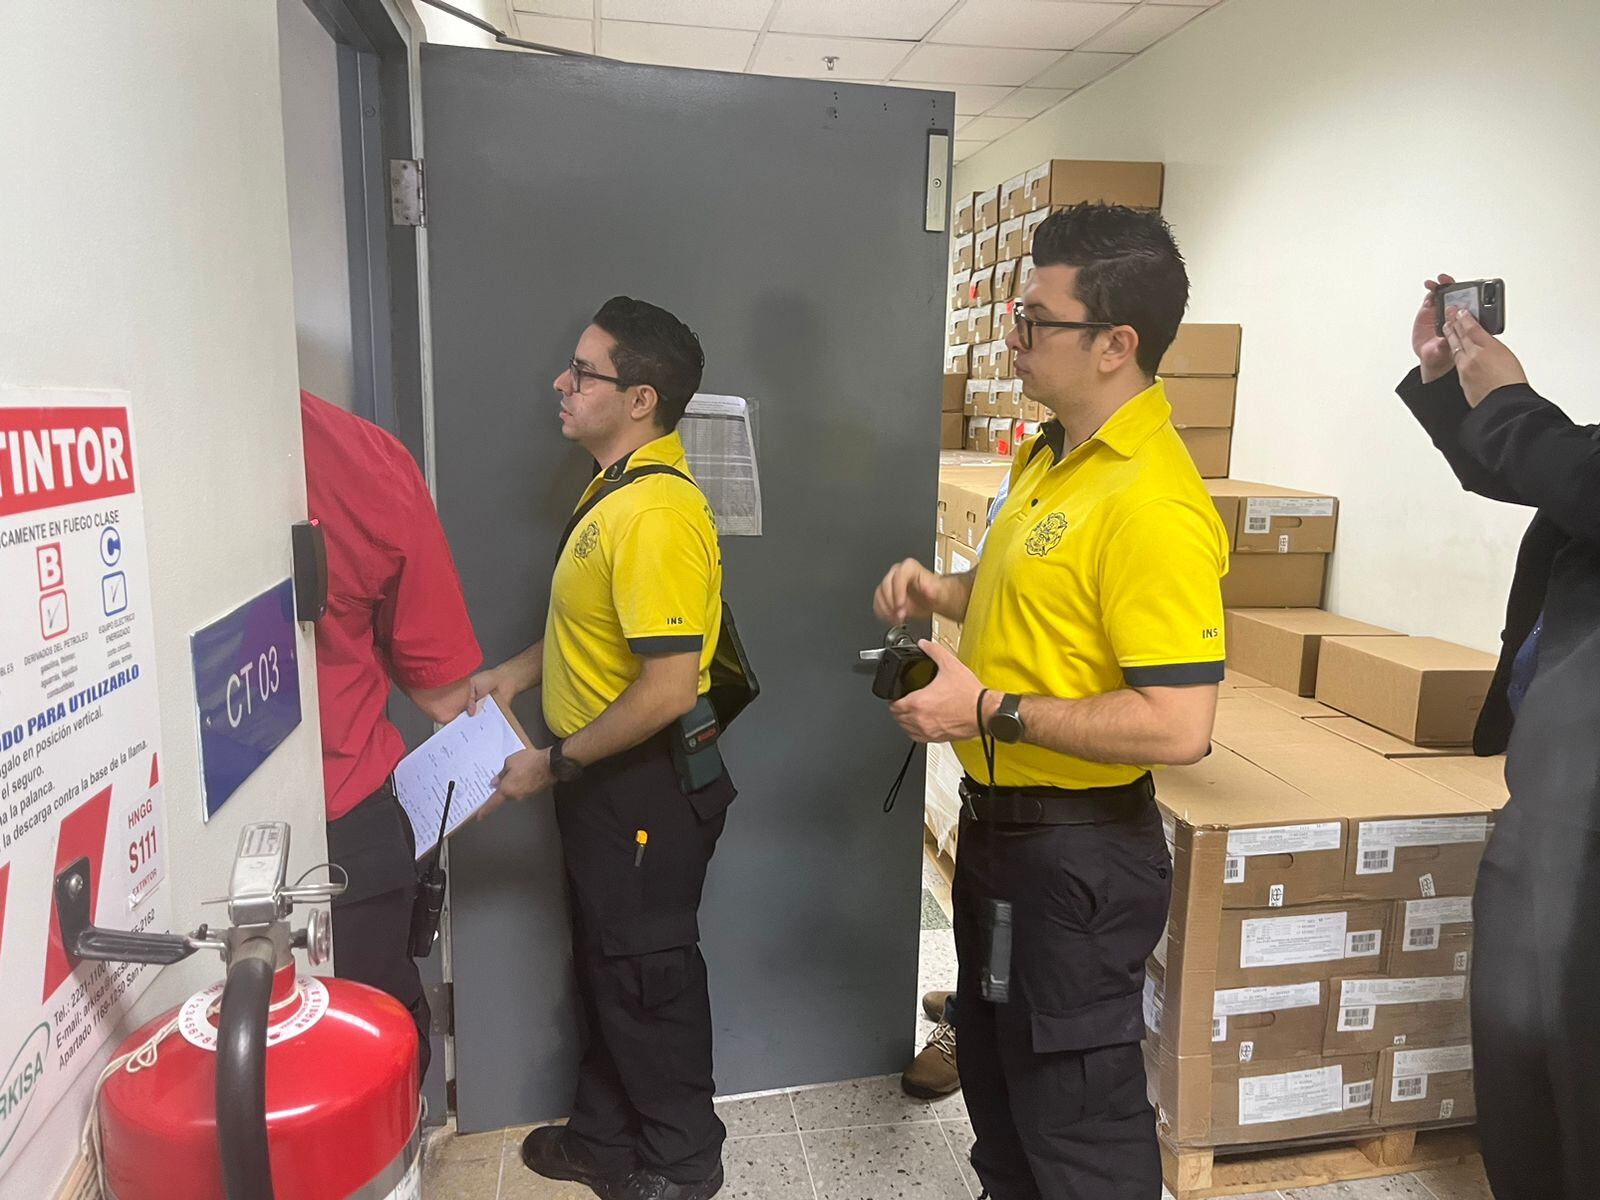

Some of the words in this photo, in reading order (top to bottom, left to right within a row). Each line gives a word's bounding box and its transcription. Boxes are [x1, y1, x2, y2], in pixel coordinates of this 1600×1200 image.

[0, 523, 47, 549] CAMENTE
[50, 521, 61, 536] EN
[64, 515, 92, 533] FUEGO
[94, 510, 120, 526] CLASE
[101, 527, 121, 566] C
[40, 546, 63, 589] B
[667, 617, 683, 625] INS
[1202, 628, 1218, 639] INS
[53, 642, 63, 653] DEL
[226, 662, 253, 729] CT
[258, 645, 280, 702] 03
[0, 724, 24, 752] DO
[27, 702, 66, 737] PARA
[69, 664, 140, 713] UTILIZARLO
[0, 754, 21, 779] galo
[23, 747, 34, 762] en
[36, 723, 72, 758] posición
[73, 705, 104, 732] vertical.
[1, 782, 10, 800] el
[12, 765, 44, 790] seguro.
[3, 833, 12, 849] la
[13, 804, 52, 841] descarga
[54, 785, 80, 811] contra
[80, 776, 89, 792] la
[89, 766, 109, 786] base
[109, 757, 119, 772] de
[119, 752, 128, 765] la
[127, 740, 148, 760] llama.
[9, 804, 18, 820] la
[19, 780, 55, 816] palanca.
[127, 798, 153, 830] HNGG
[128, 825, 157, 875] S111
[132, 868, 158, 898] EXTINTOR
[54, 1001, 71, 1027] Tel.:
[56, 1011, 83, 1049] E-mail:
[60, 1023, 92, 1071] Apartado
[126, 967, 139, 987] San
